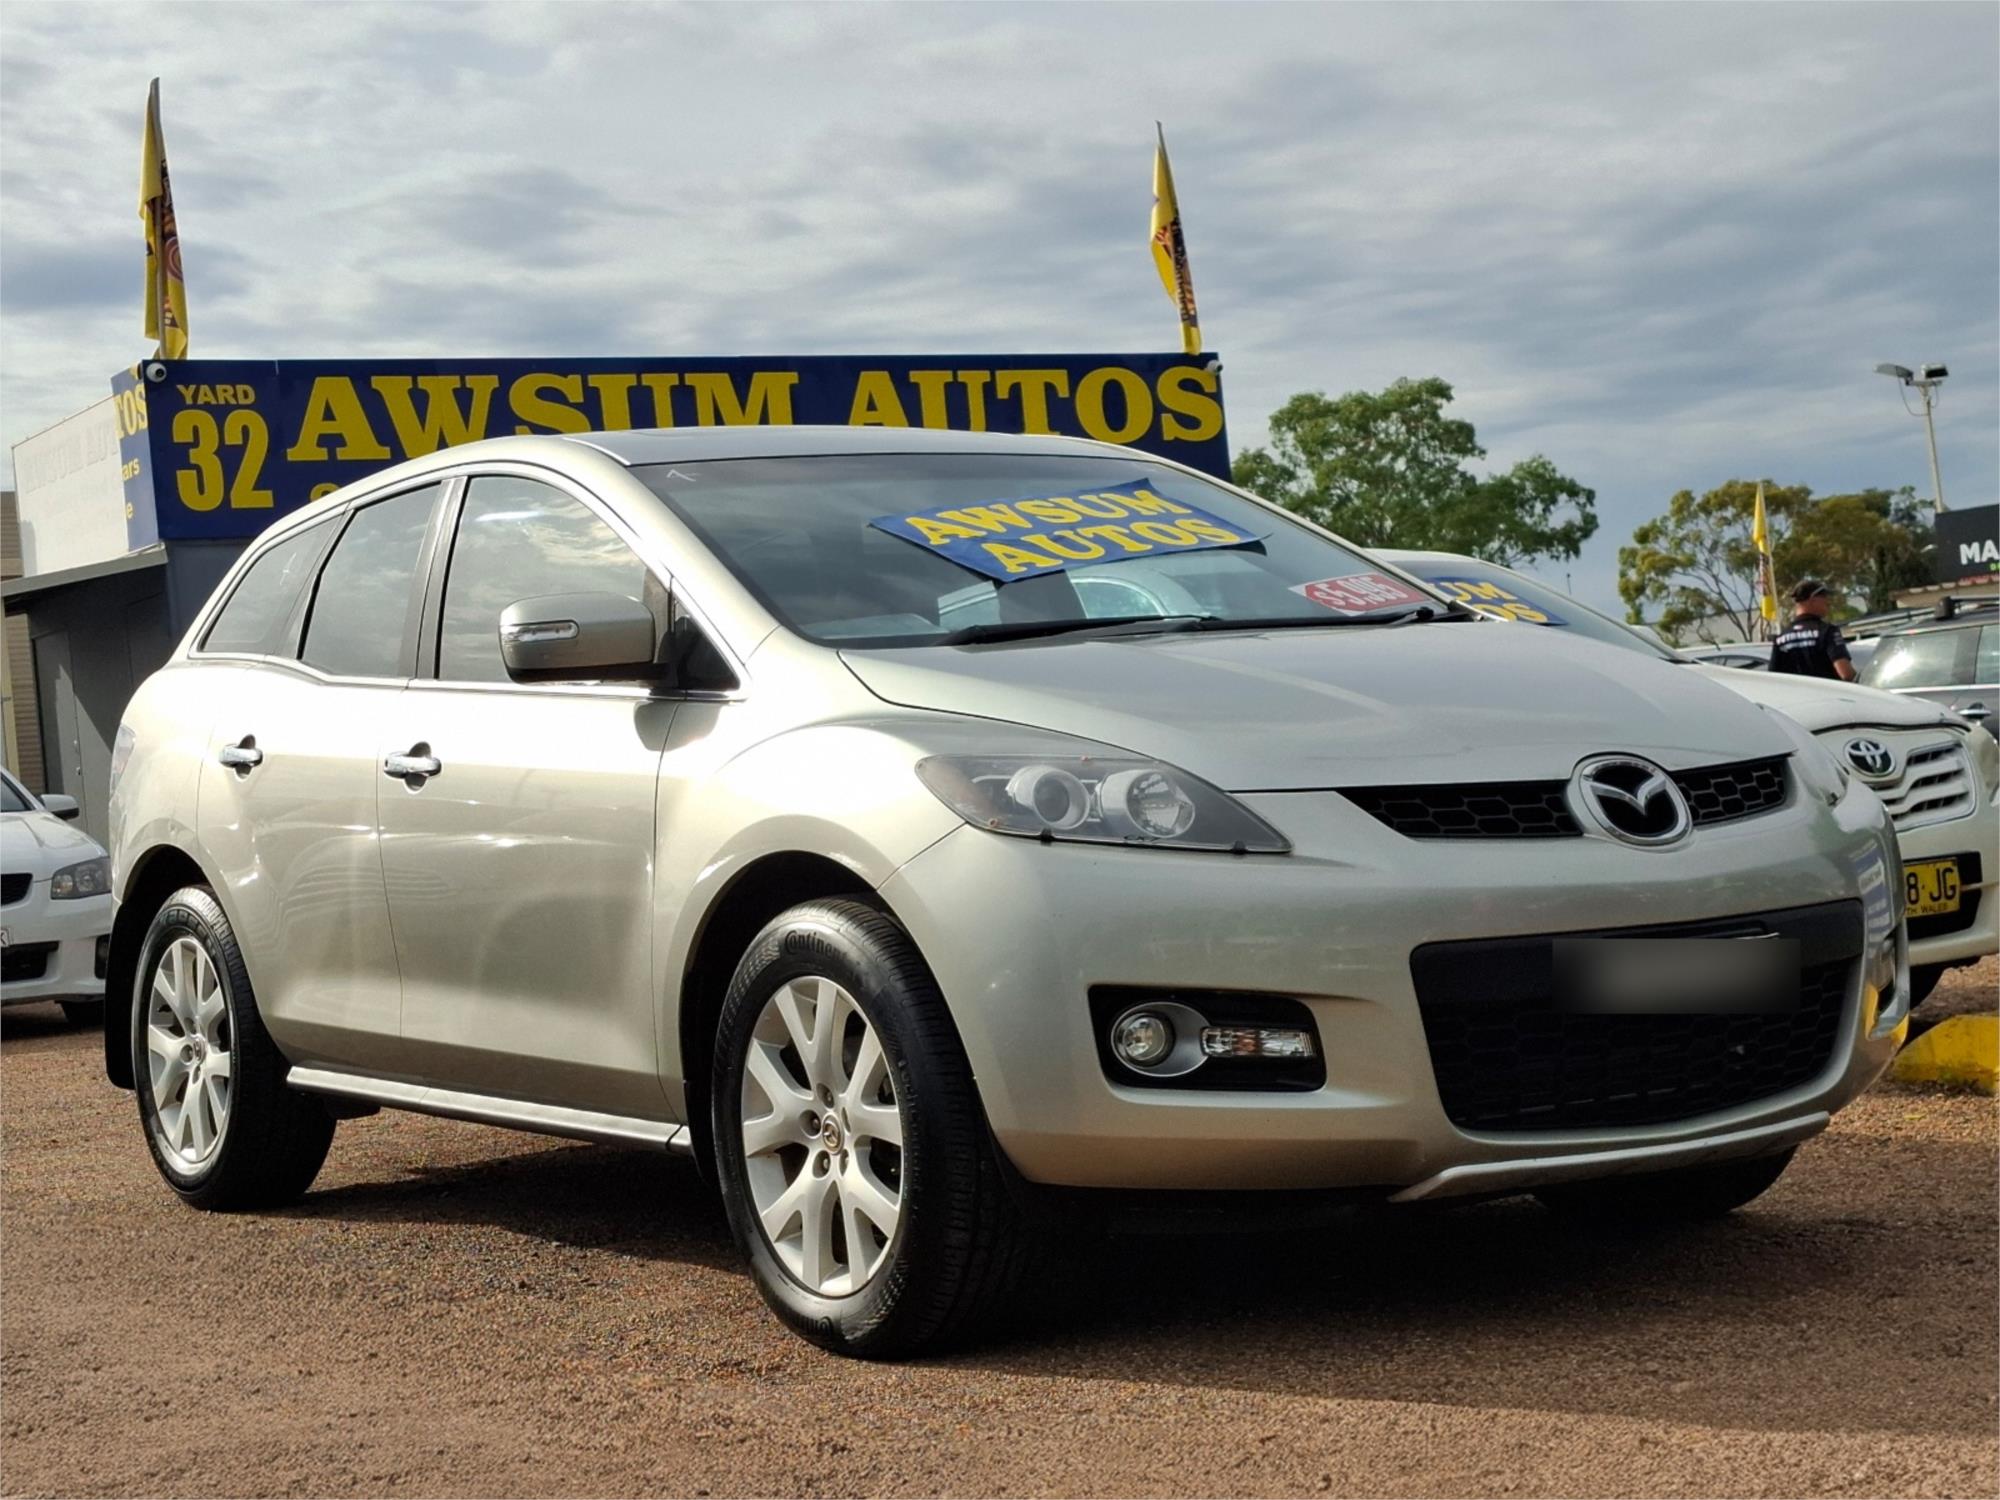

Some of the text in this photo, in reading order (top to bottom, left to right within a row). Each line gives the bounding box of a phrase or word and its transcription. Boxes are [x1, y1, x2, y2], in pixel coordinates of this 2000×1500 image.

[176, 384, 255, 405] YARD
[287, 366, 1223, 461] AWSUM AUTOS
[172, 409, 274, 511] 32
[905, 489, 1192, 545] AWSUM
[981, 518, 1241, 573] AUTOS
